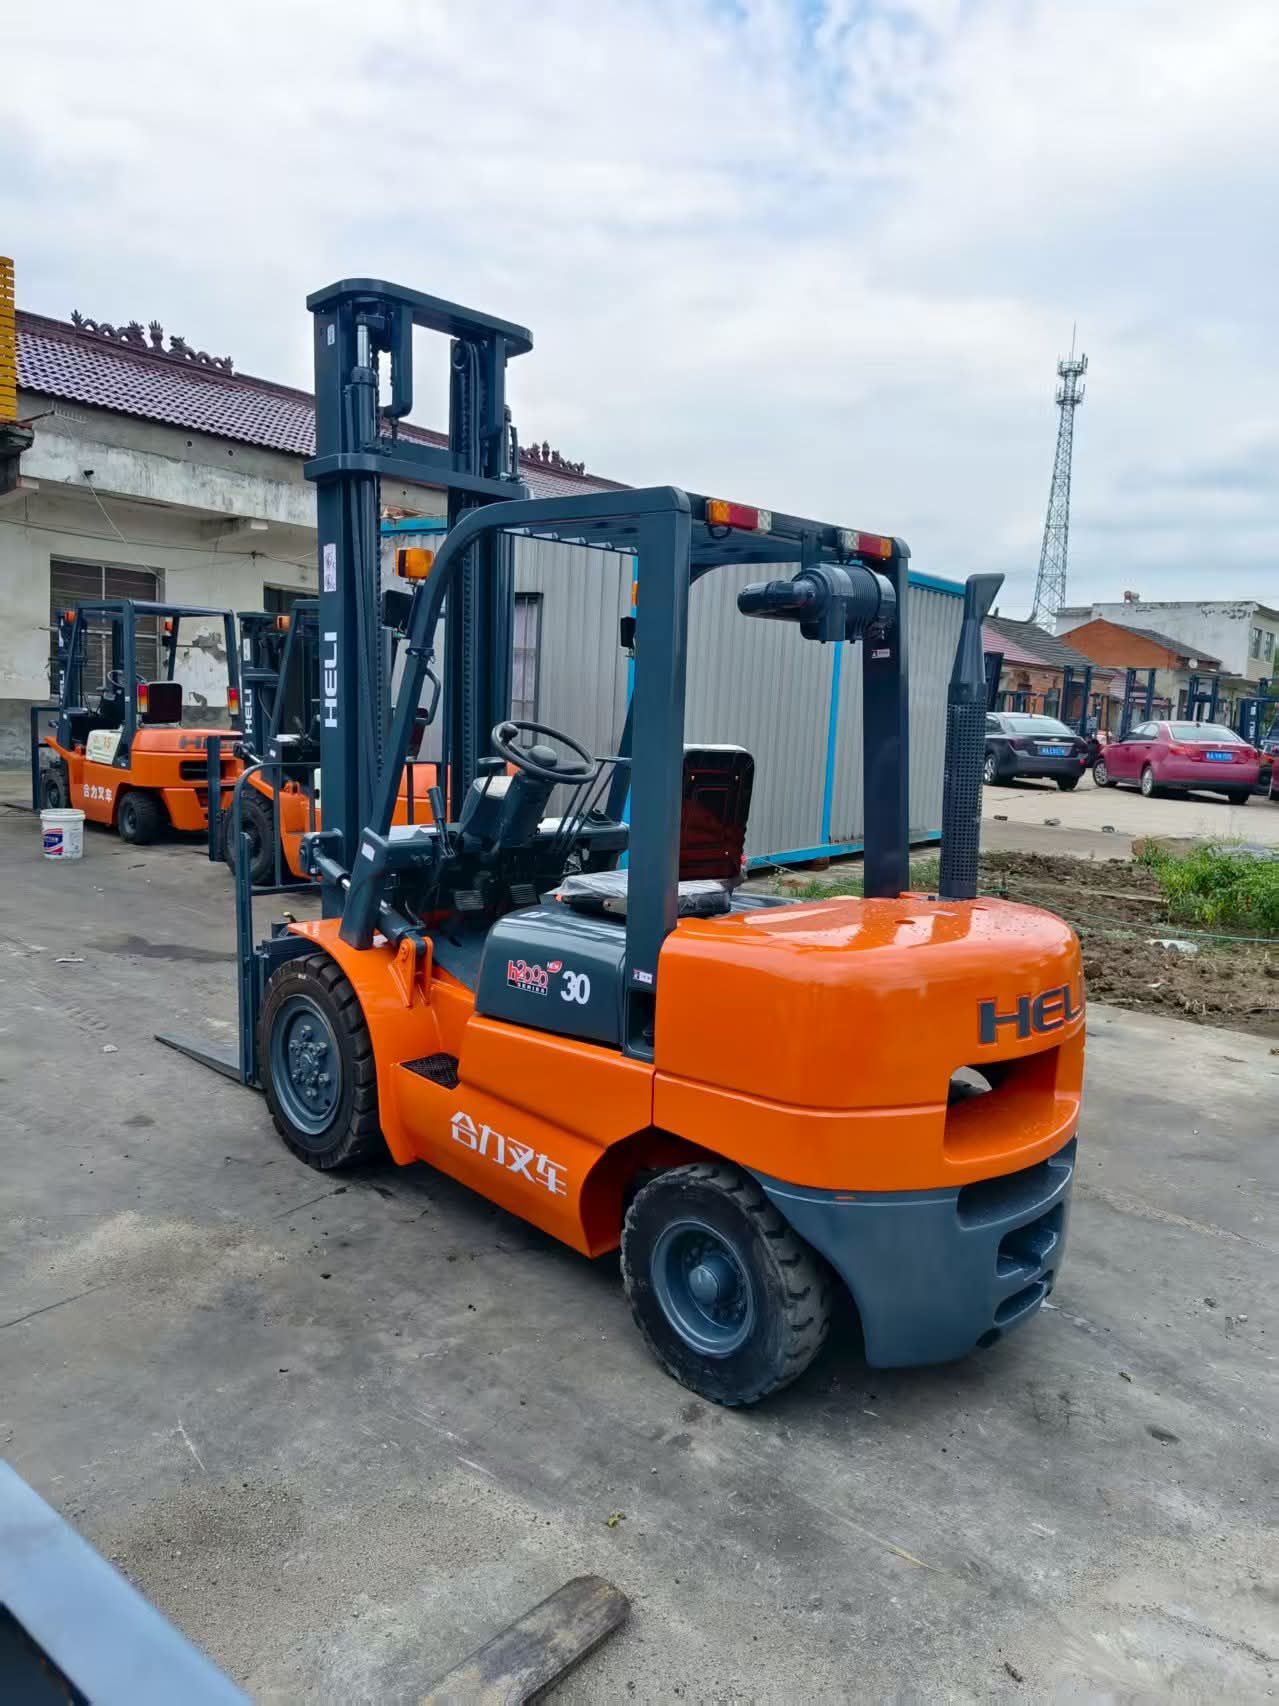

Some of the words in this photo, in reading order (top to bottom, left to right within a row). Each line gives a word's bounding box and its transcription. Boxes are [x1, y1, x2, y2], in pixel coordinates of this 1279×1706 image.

[324, 632, 338, 728] HELI
[244, 688, 253, 734] HELI
[83, 783, 112, 802] 合力叉车
[560, 970, 591, 1005] 30
[978, 984, 1084, 1045] HEL
[450, 1111, 568, 1196] 合力叉车
